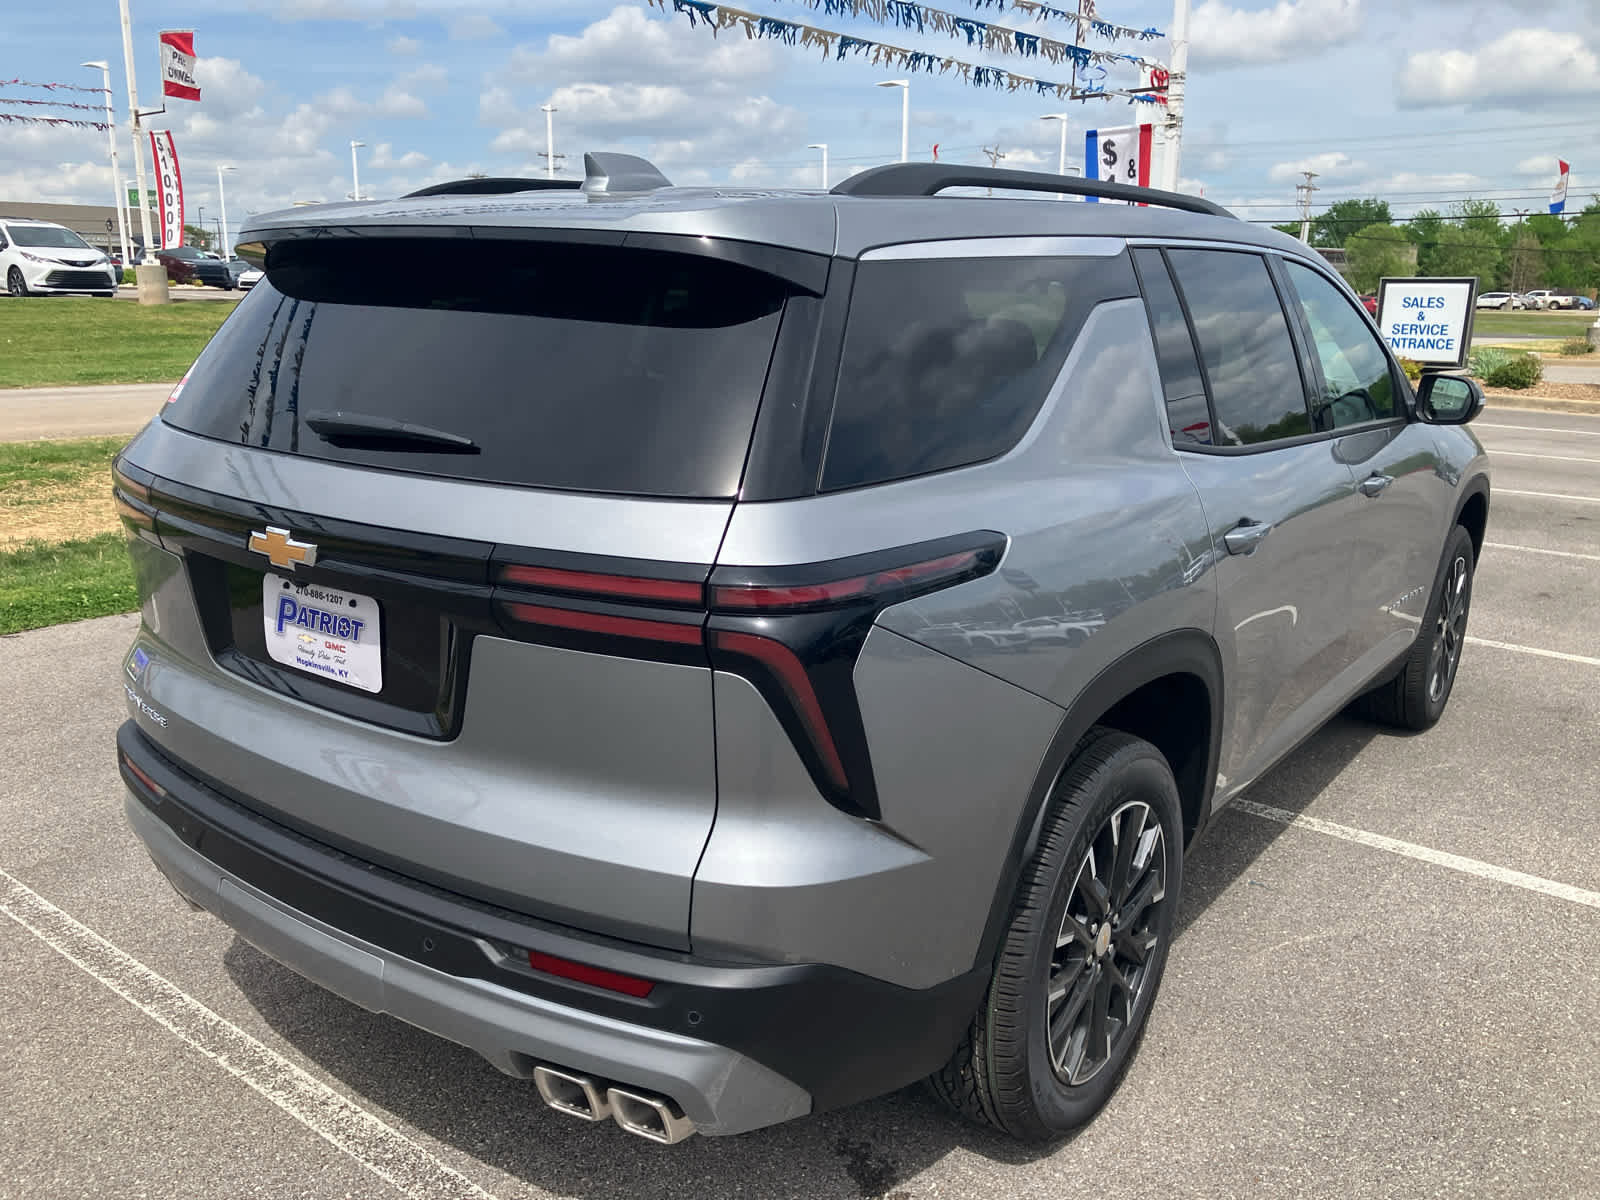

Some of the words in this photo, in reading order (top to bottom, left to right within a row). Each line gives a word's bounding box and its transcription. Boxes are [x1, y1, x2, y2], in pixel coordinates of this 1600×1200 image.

[1402, 296, 1445, 309] SALES
[1417, 311, 1425, 321] &
[1391, 323, 1449, 336] SERVICE
[324, 640, 347, 654] GMC
[296, 656, 338, 677] Hopkinsville,
[338, 669, 349, 679] KY
